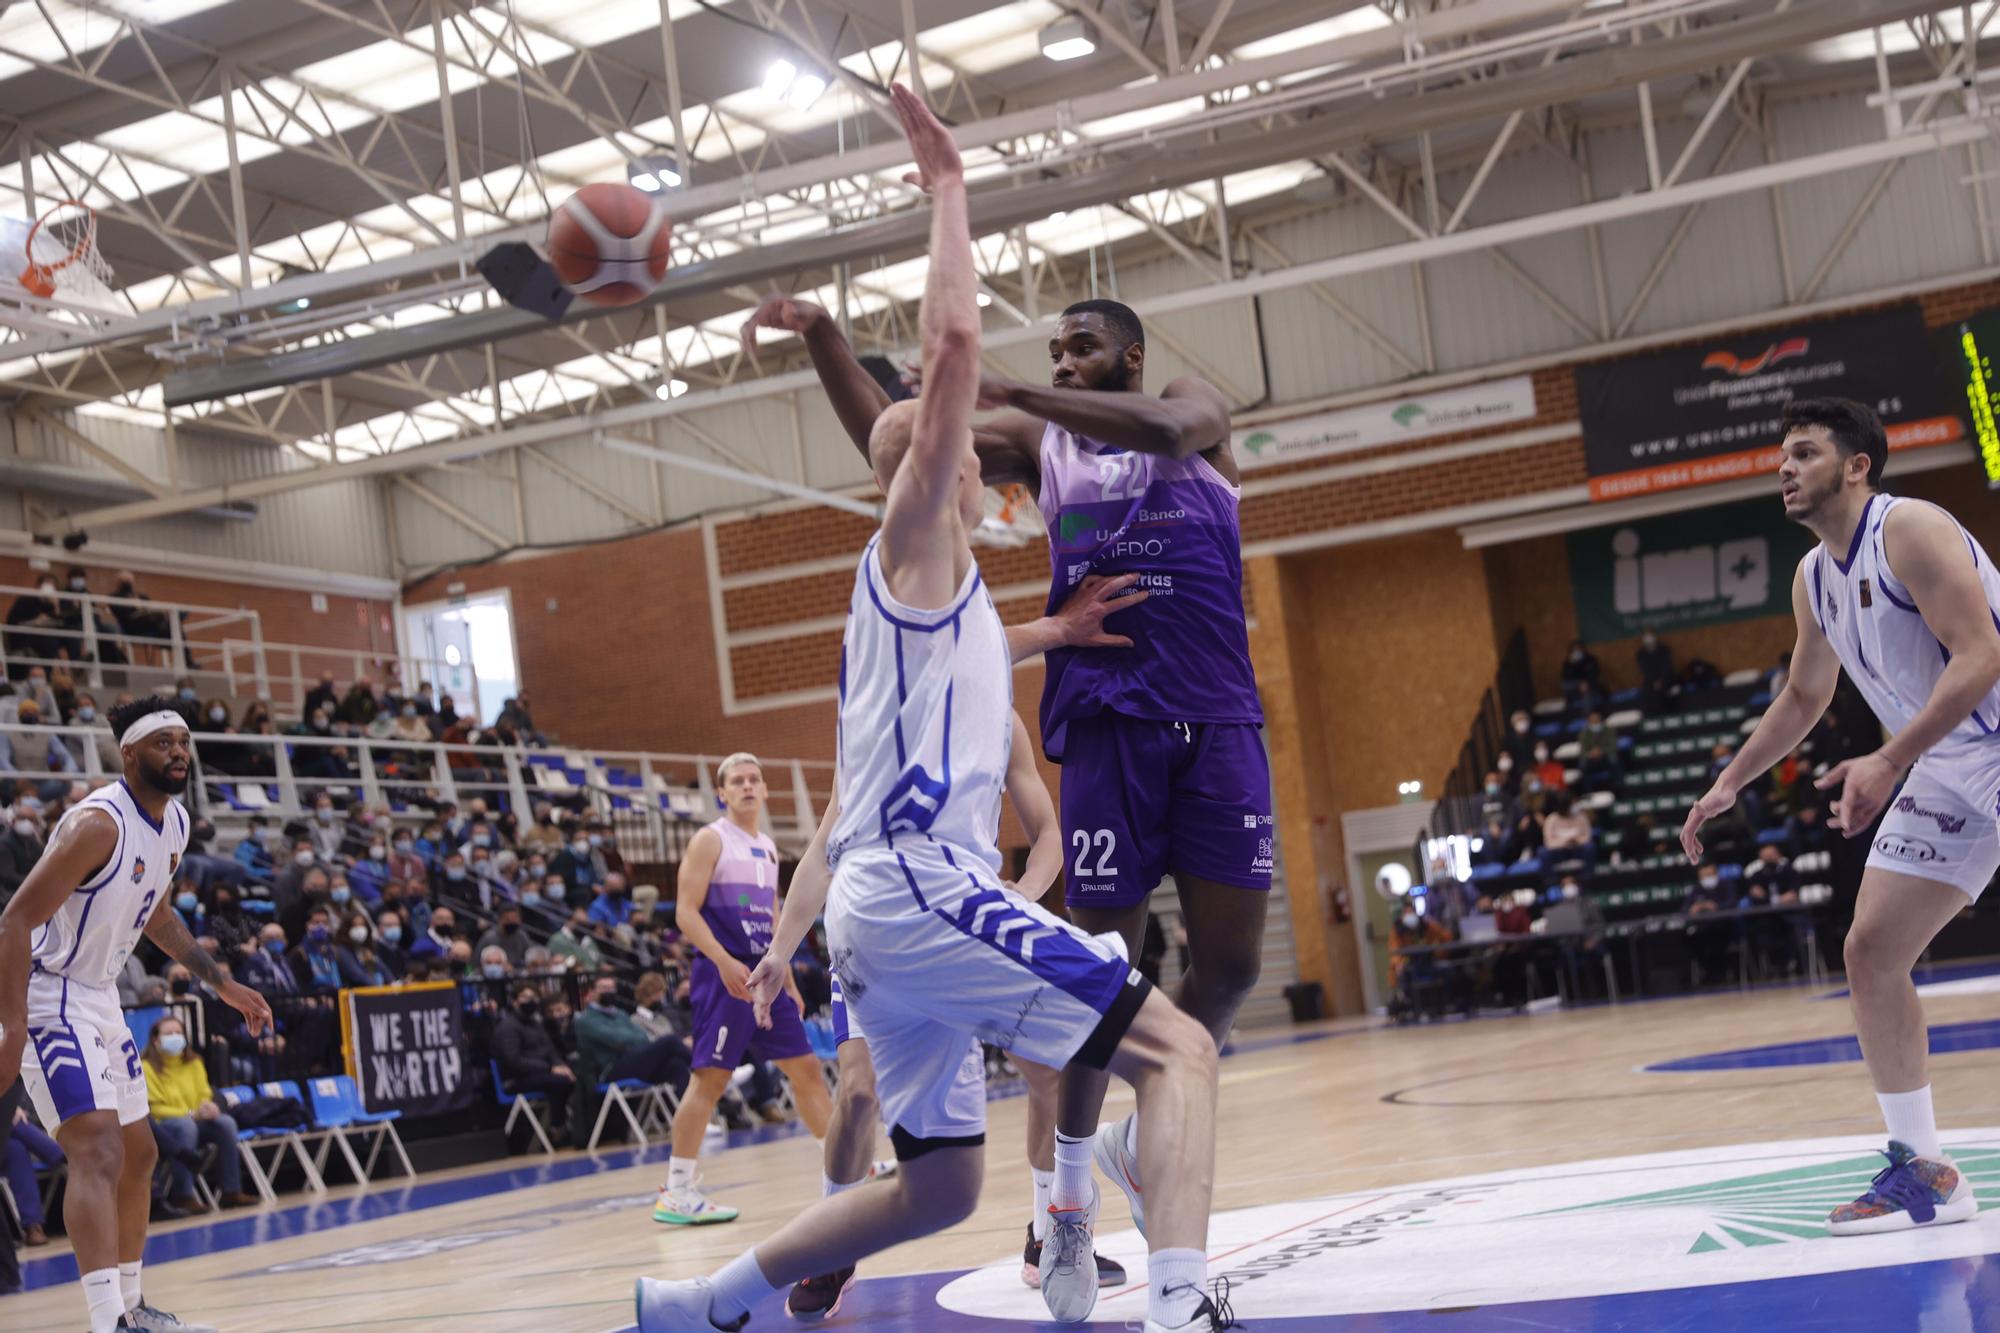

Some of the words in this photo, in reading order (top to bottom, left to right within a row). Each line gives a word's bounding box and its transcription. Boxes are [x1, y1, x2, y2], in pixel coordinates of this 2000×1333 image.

[1100, 451, 1146, 501] 22
[1138, 509, 1185, 522] Banco
[1073, 829, 1118, 877] 22
[1081, 883, 1115, 892] SPALDING
[369, 1012, 404, 1053] WE
[409, 1007, 453, 1049] THE
[122, 1038, 143, 1080] 2
